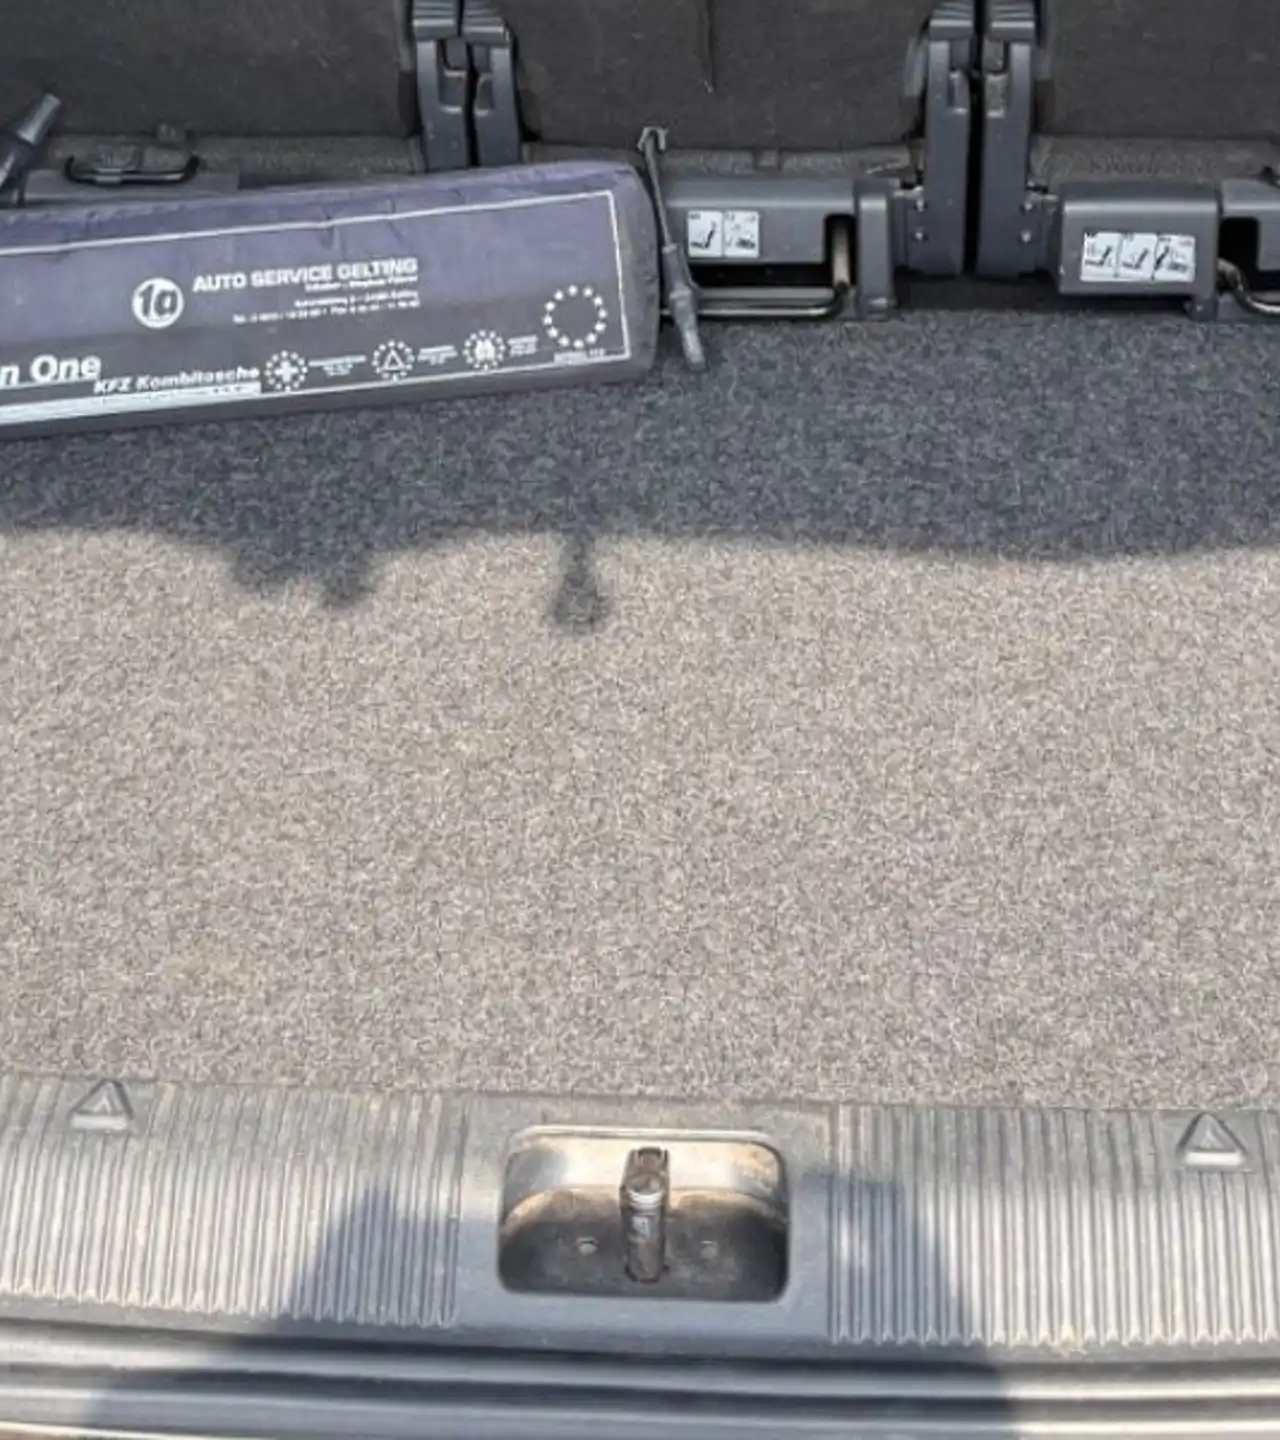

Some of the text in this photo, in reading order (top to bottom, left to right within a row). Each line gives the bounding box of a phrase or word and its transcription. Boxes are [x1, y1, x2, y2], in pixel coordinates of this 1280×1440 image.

[192, 271, 248, 293] AUTO
[251, 264, 333, 288] SERVICE
[337, 257, 418, 280] GELTING
[30, 354, 102, 383] One
